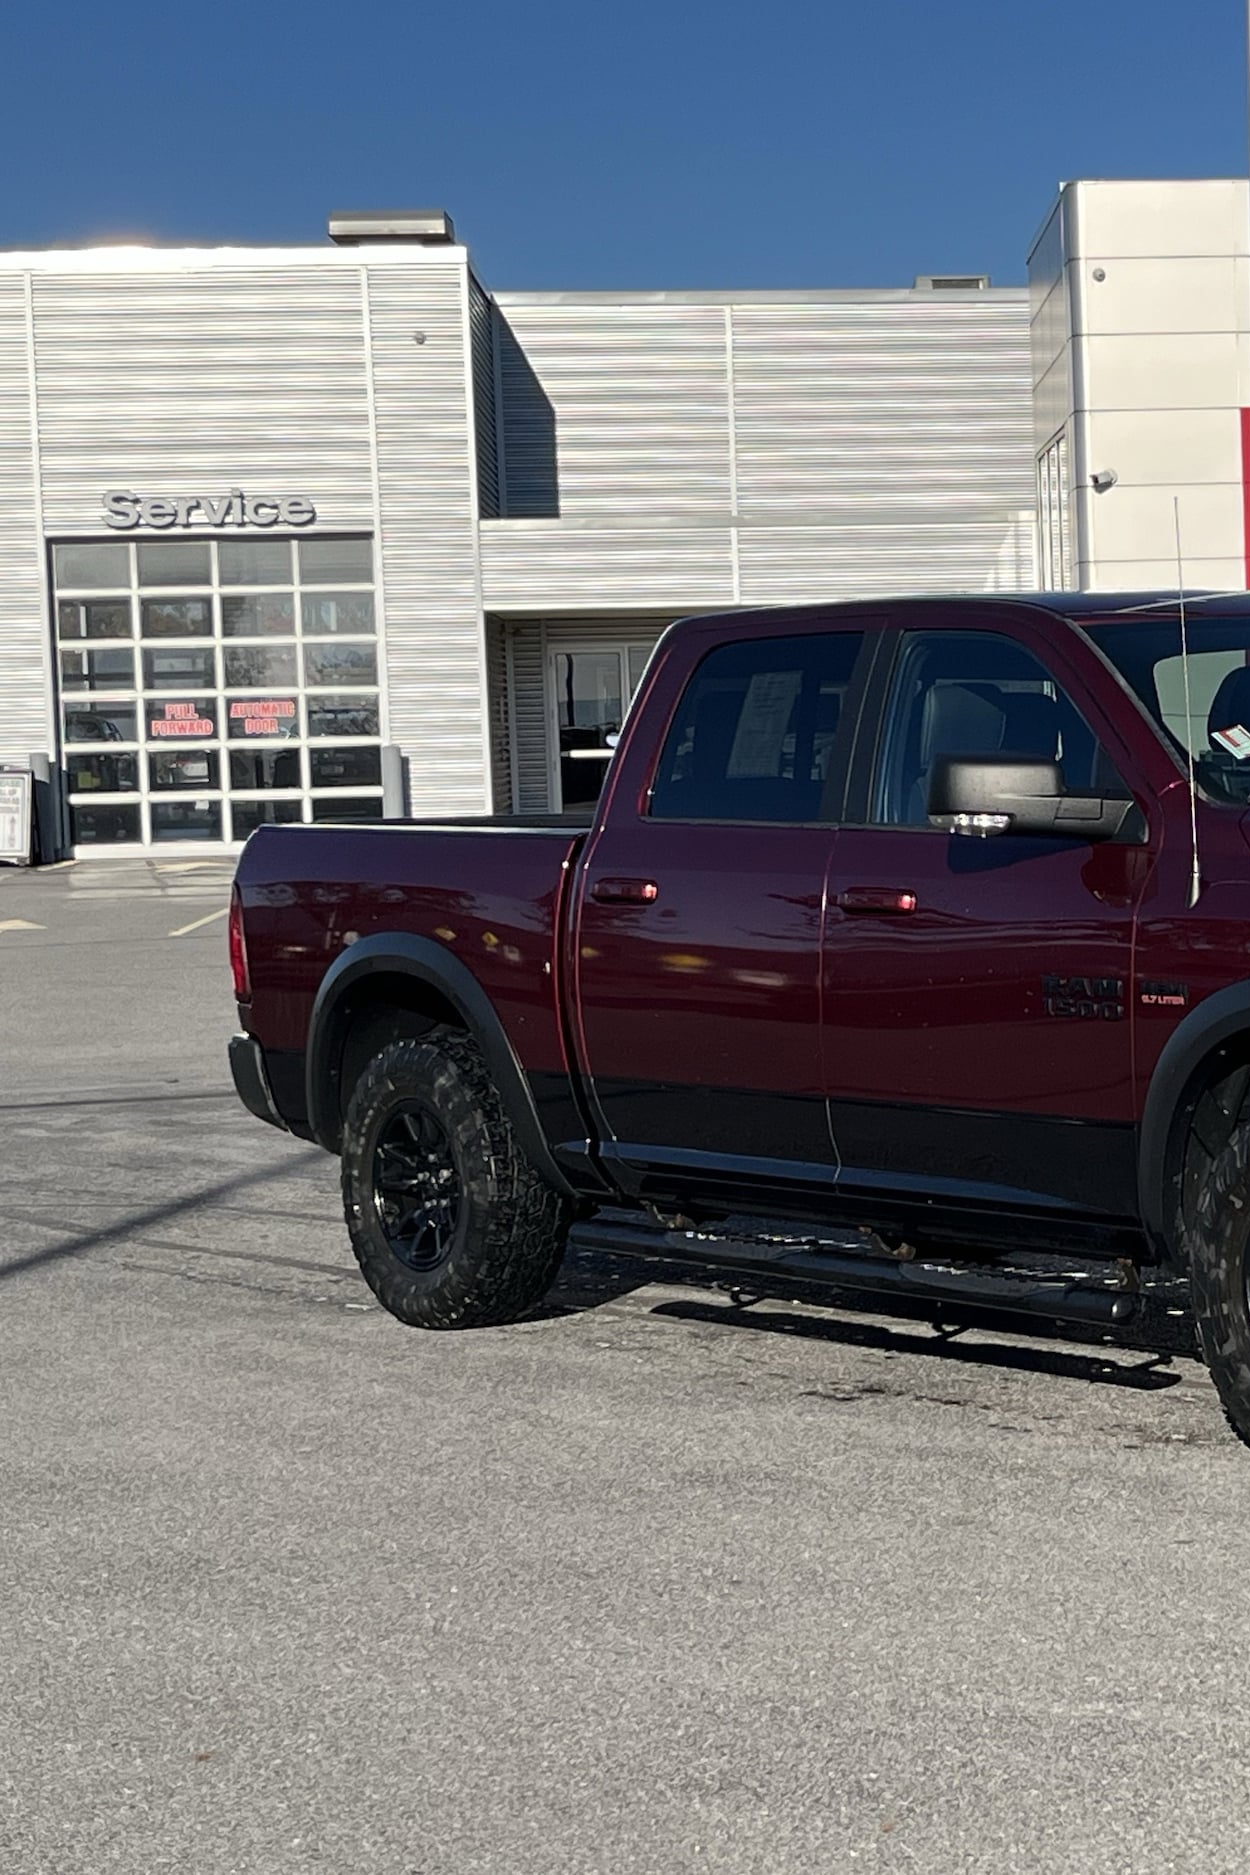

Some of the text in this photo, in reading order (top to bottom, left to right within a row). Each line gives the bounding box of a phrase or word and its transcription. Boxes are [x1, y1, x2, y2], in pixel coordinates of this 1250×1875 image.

[102, 488, 315, 528] Service
[165, 703, 198, 719] PULL
[230, 701, 295, 718] AUTOMATIC
[152, 719, 213, 736] FORWARD
[245, 718, 278, 734] DOOR
[1042, 975, 1124, 998] RAM
[1042, 998, 1124, 1021] 1500
